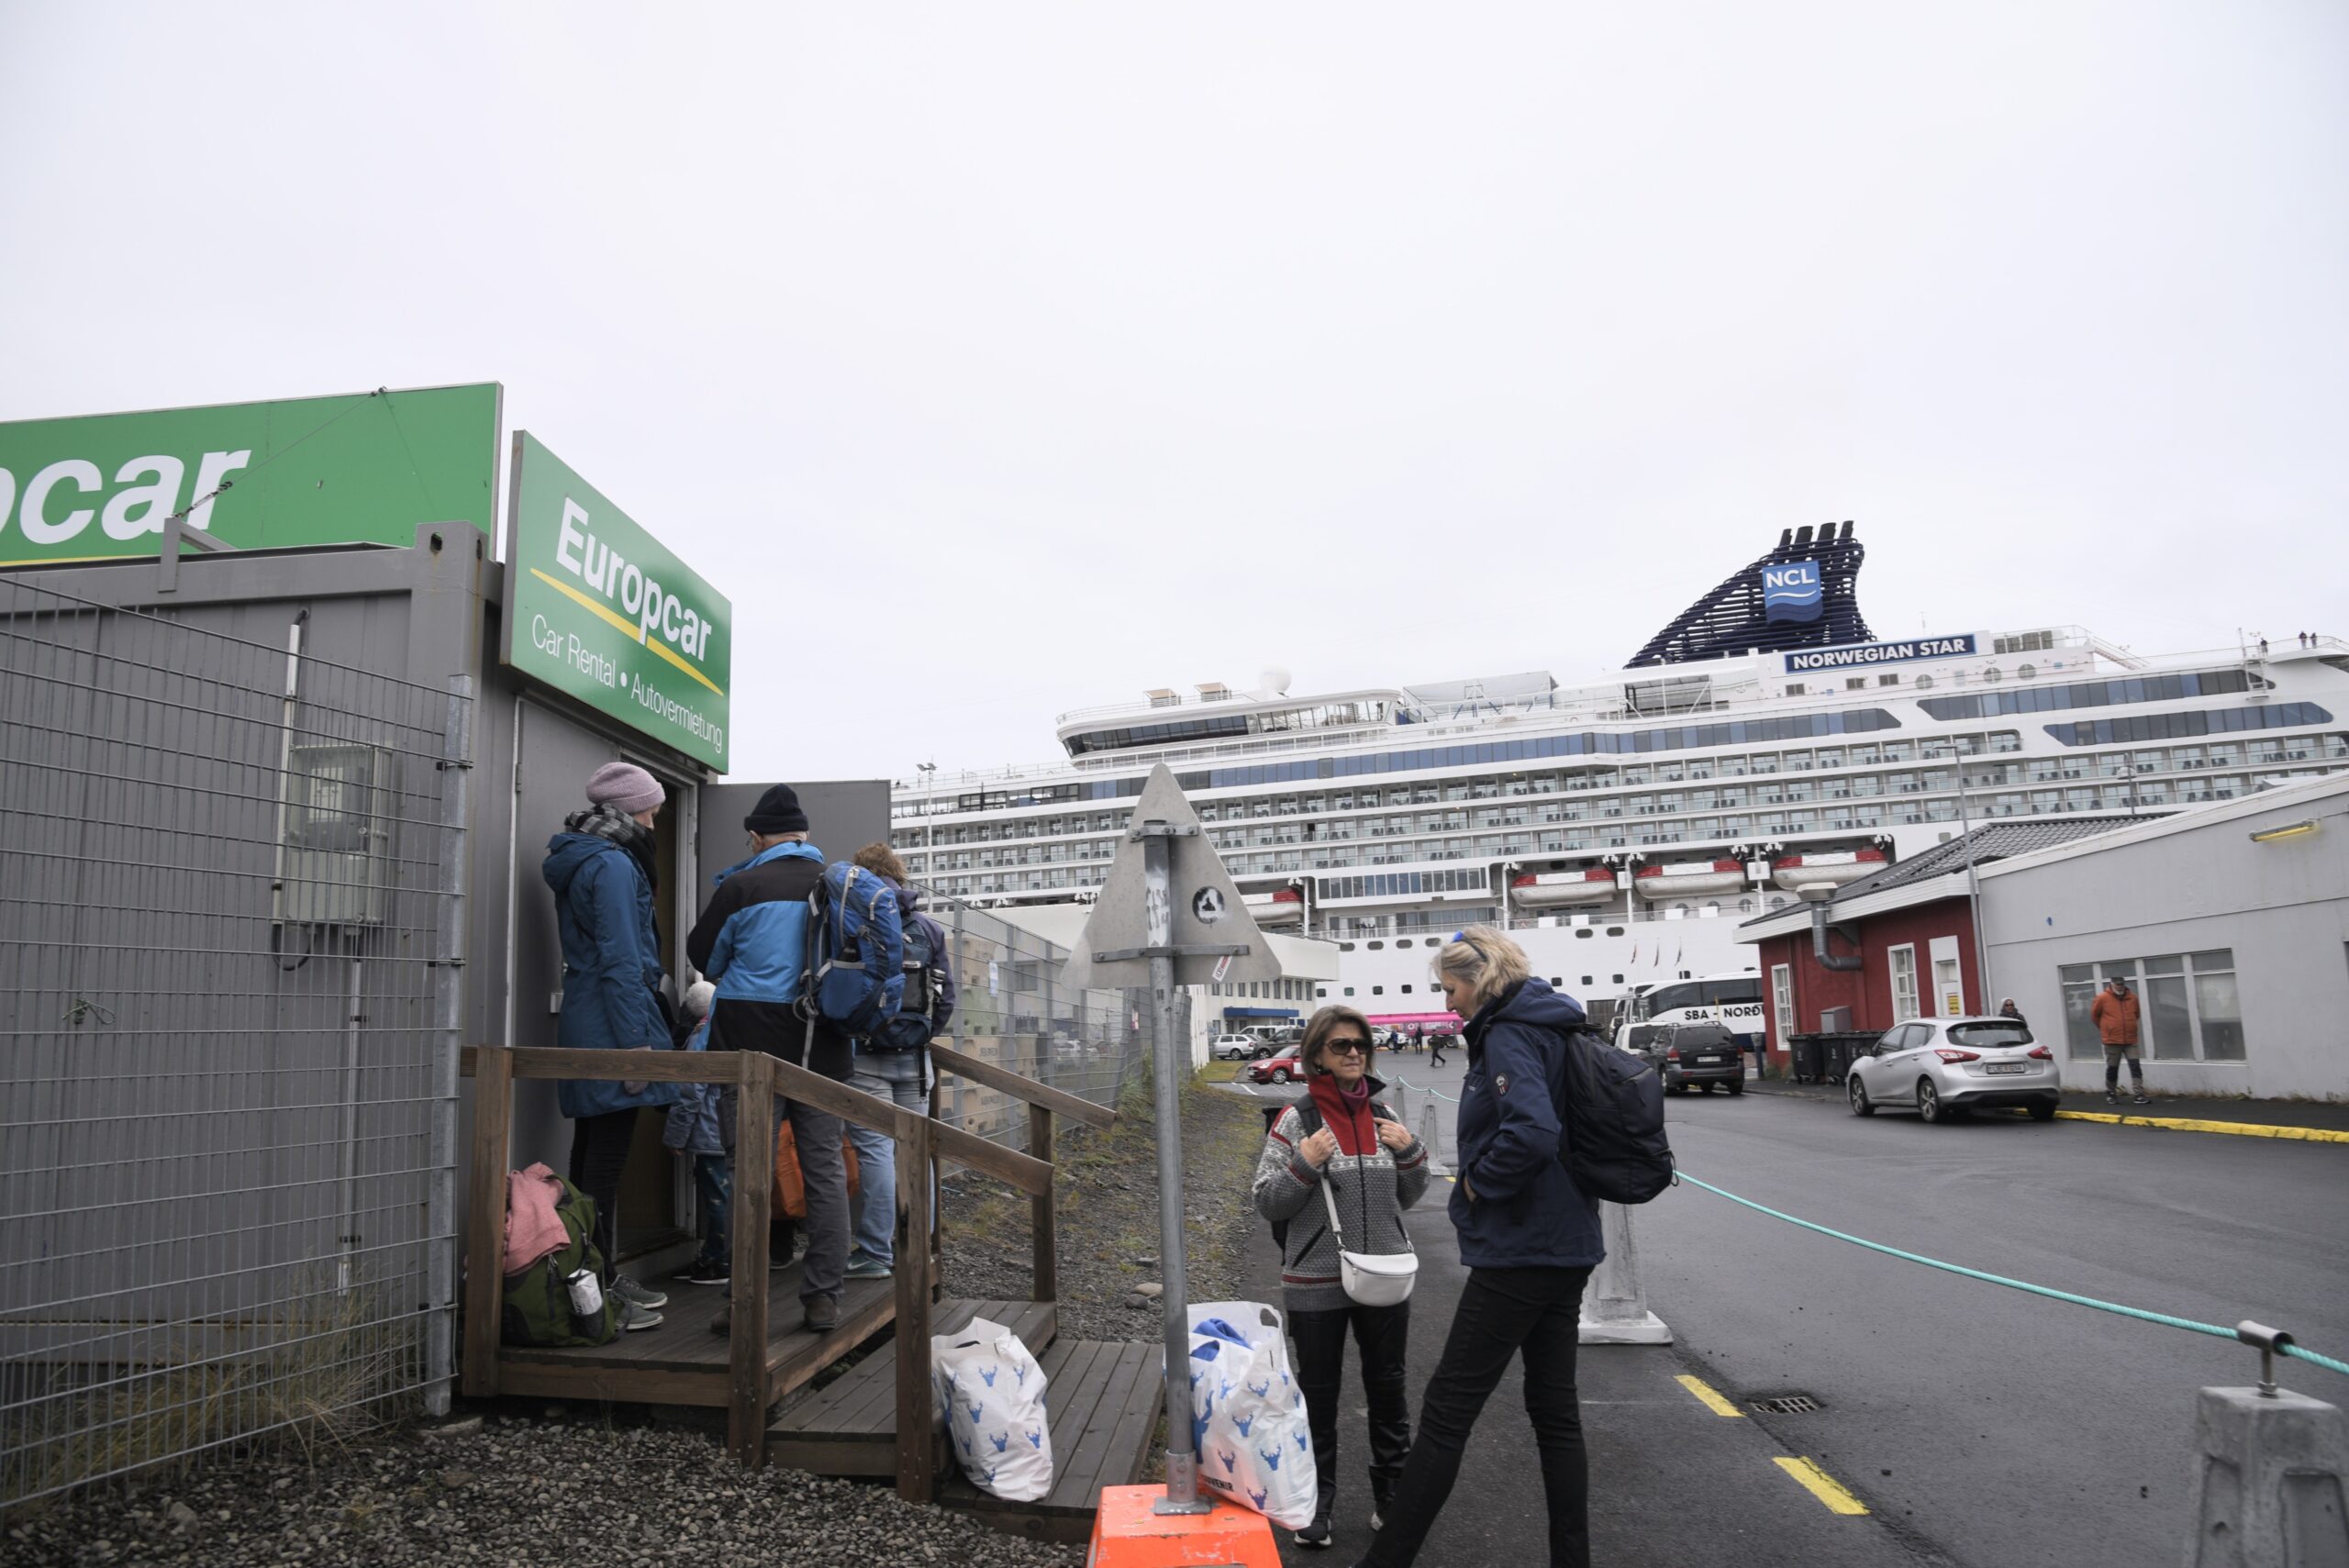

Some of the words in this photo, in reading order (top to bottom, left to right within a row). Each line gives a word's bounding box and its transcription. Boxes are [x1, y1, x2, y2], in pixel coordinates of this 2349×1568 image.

[556, 496, 712, 662] Europcar
[1765, 568, 1816, 588] NCL
[1793, 643, 1914, 669] NORWEGIAN
[1920, 639, 1966, 656] STAR
[532, 614, 563, 658] Car
[568, 632, 616, 688] Rental
[631, 673, 722, 753] Autovermietung
[1685, 1010, 1709, 1020] SBA
